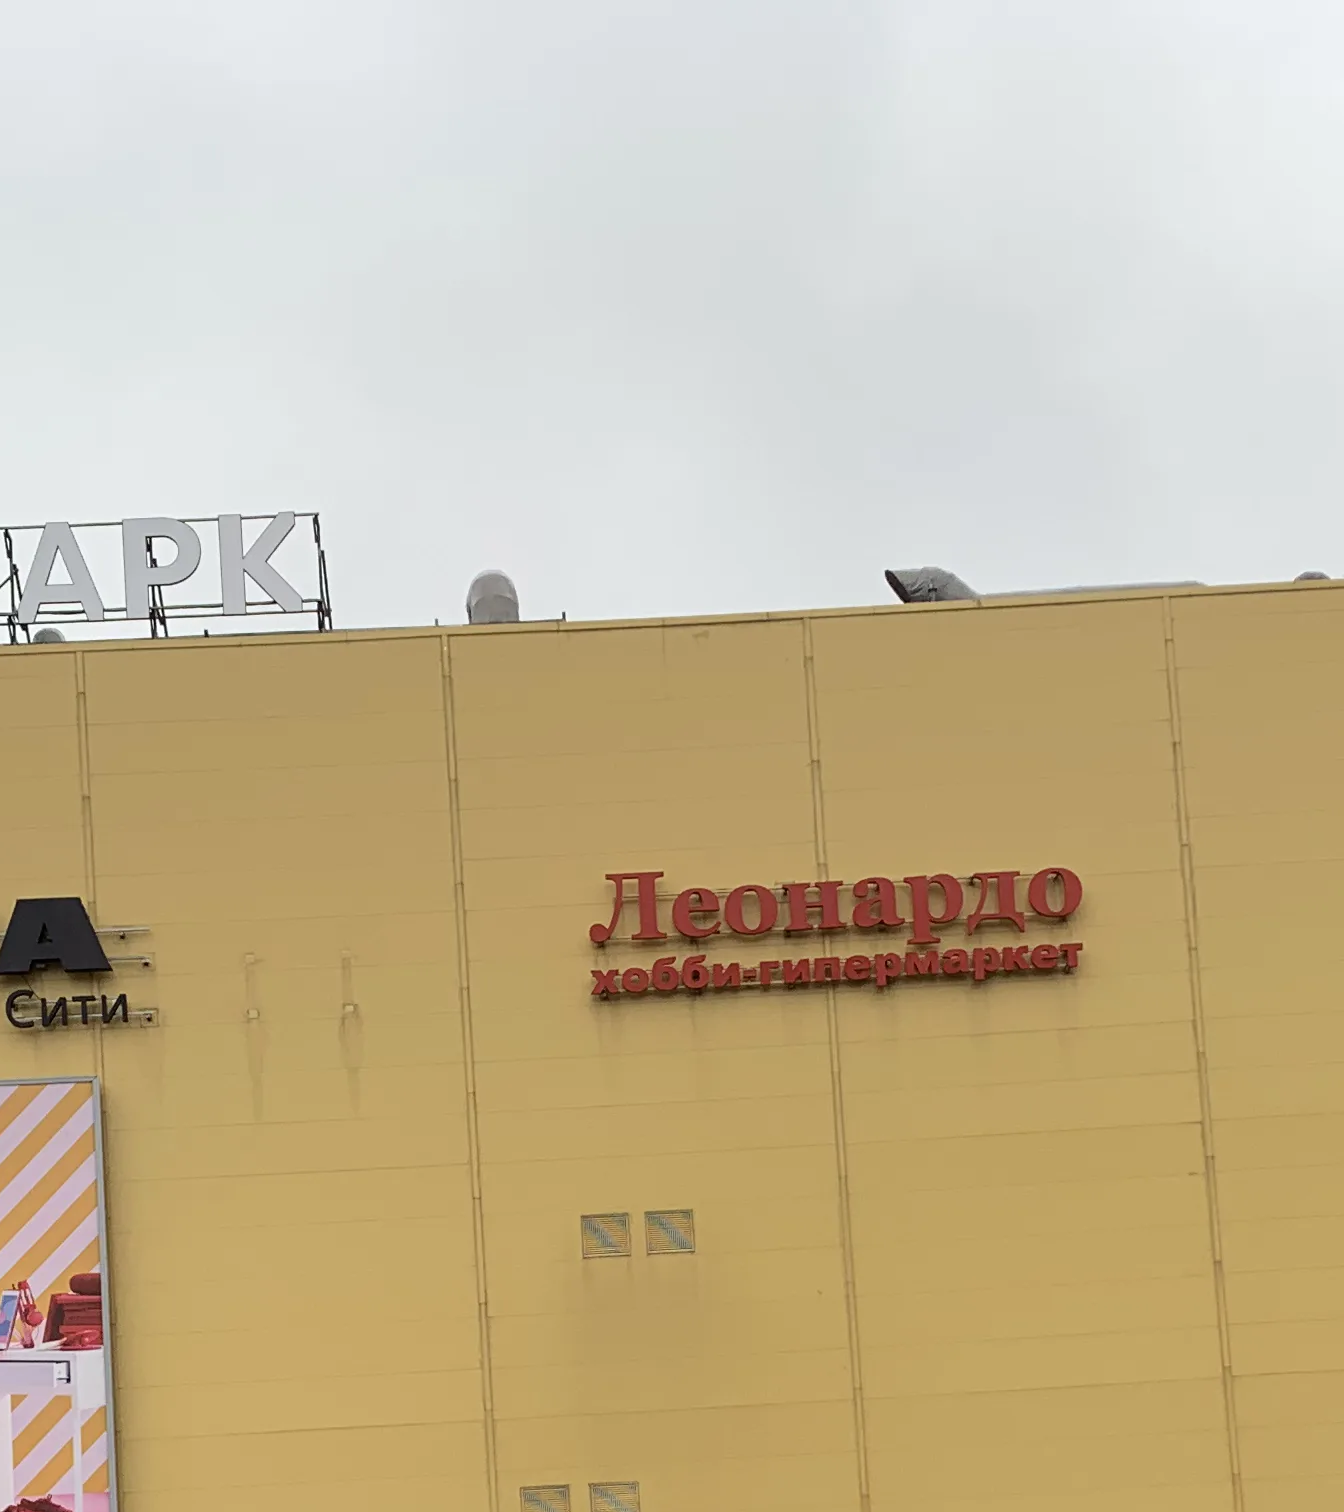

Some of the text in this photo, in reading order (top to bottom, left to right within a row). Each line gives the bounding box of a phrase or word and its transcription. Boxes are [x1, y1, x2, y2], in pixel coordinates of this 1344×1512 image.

[589, 867, 1083, 944] Леонардо
[590, 942, 1083, 996] хобби-гипермаркет
[5, 989, 128, 1029] Сити
